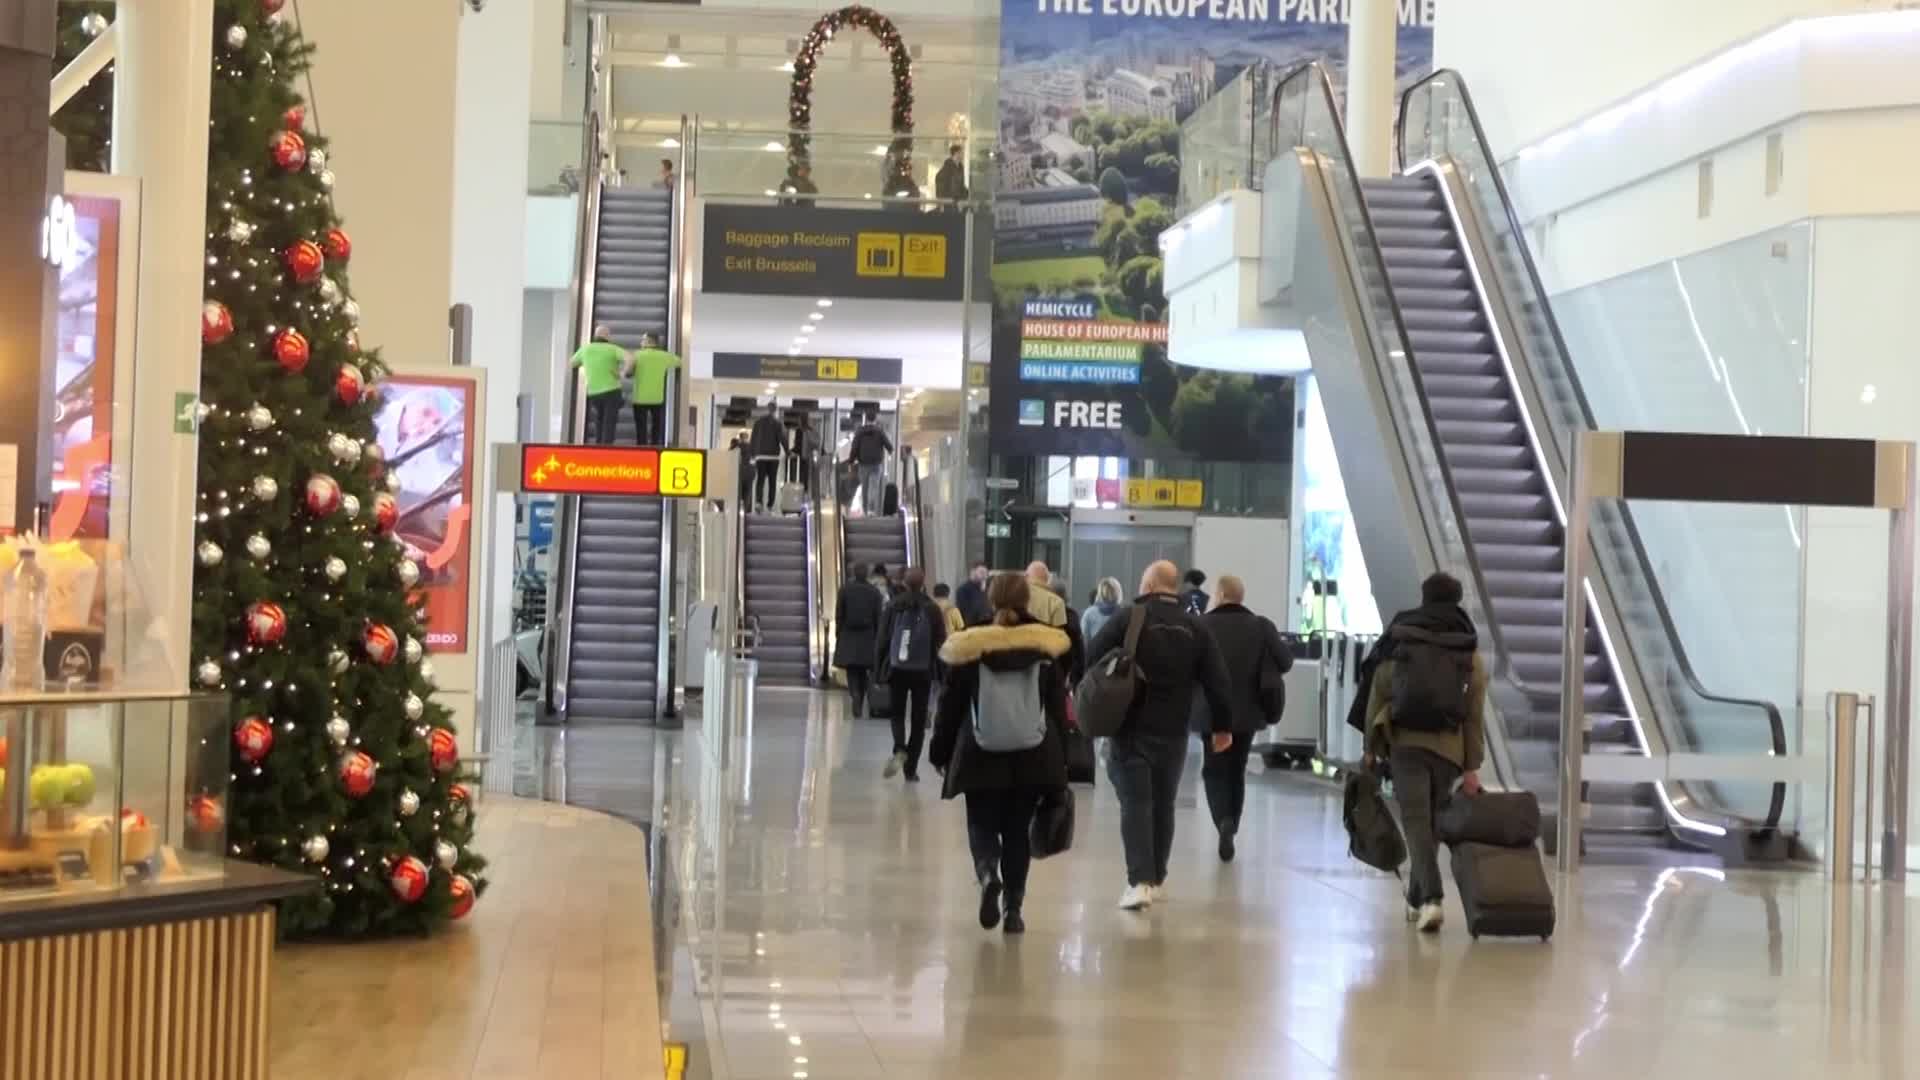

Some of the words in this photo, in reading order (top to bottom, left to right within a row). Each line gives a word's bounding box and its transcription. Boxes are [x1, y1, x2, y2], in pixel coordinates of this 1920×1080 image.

[1102, 0, 1268, 21] EUROPEAN
[725, 231, 789, 248] Baggage
[793, 232, 850, 247] Reclaim
[909, 239, 939, 254] Exit
[725, 256, 751, 271] Exit
[756, 257, 816, 273] Brussels
[1025, 302, 1094, 317] HEMICYCLE
[1025, 323, 1066, 337] HOUSE
[1068, 324, 1080, 337] OF
[1086, 324, 1150, 339] EUROPEAN
[1025, 343, 1137, 360] PARLAMENTARIUM
[1024, 365, 1067, 378] ONLINE
[1071, 366, 1136, 380] ACTIVITIES
[1053, 401, 1123, 429] FREE
[564, 462, 652, 480] Connections
[672, 467, 690, 490] B
